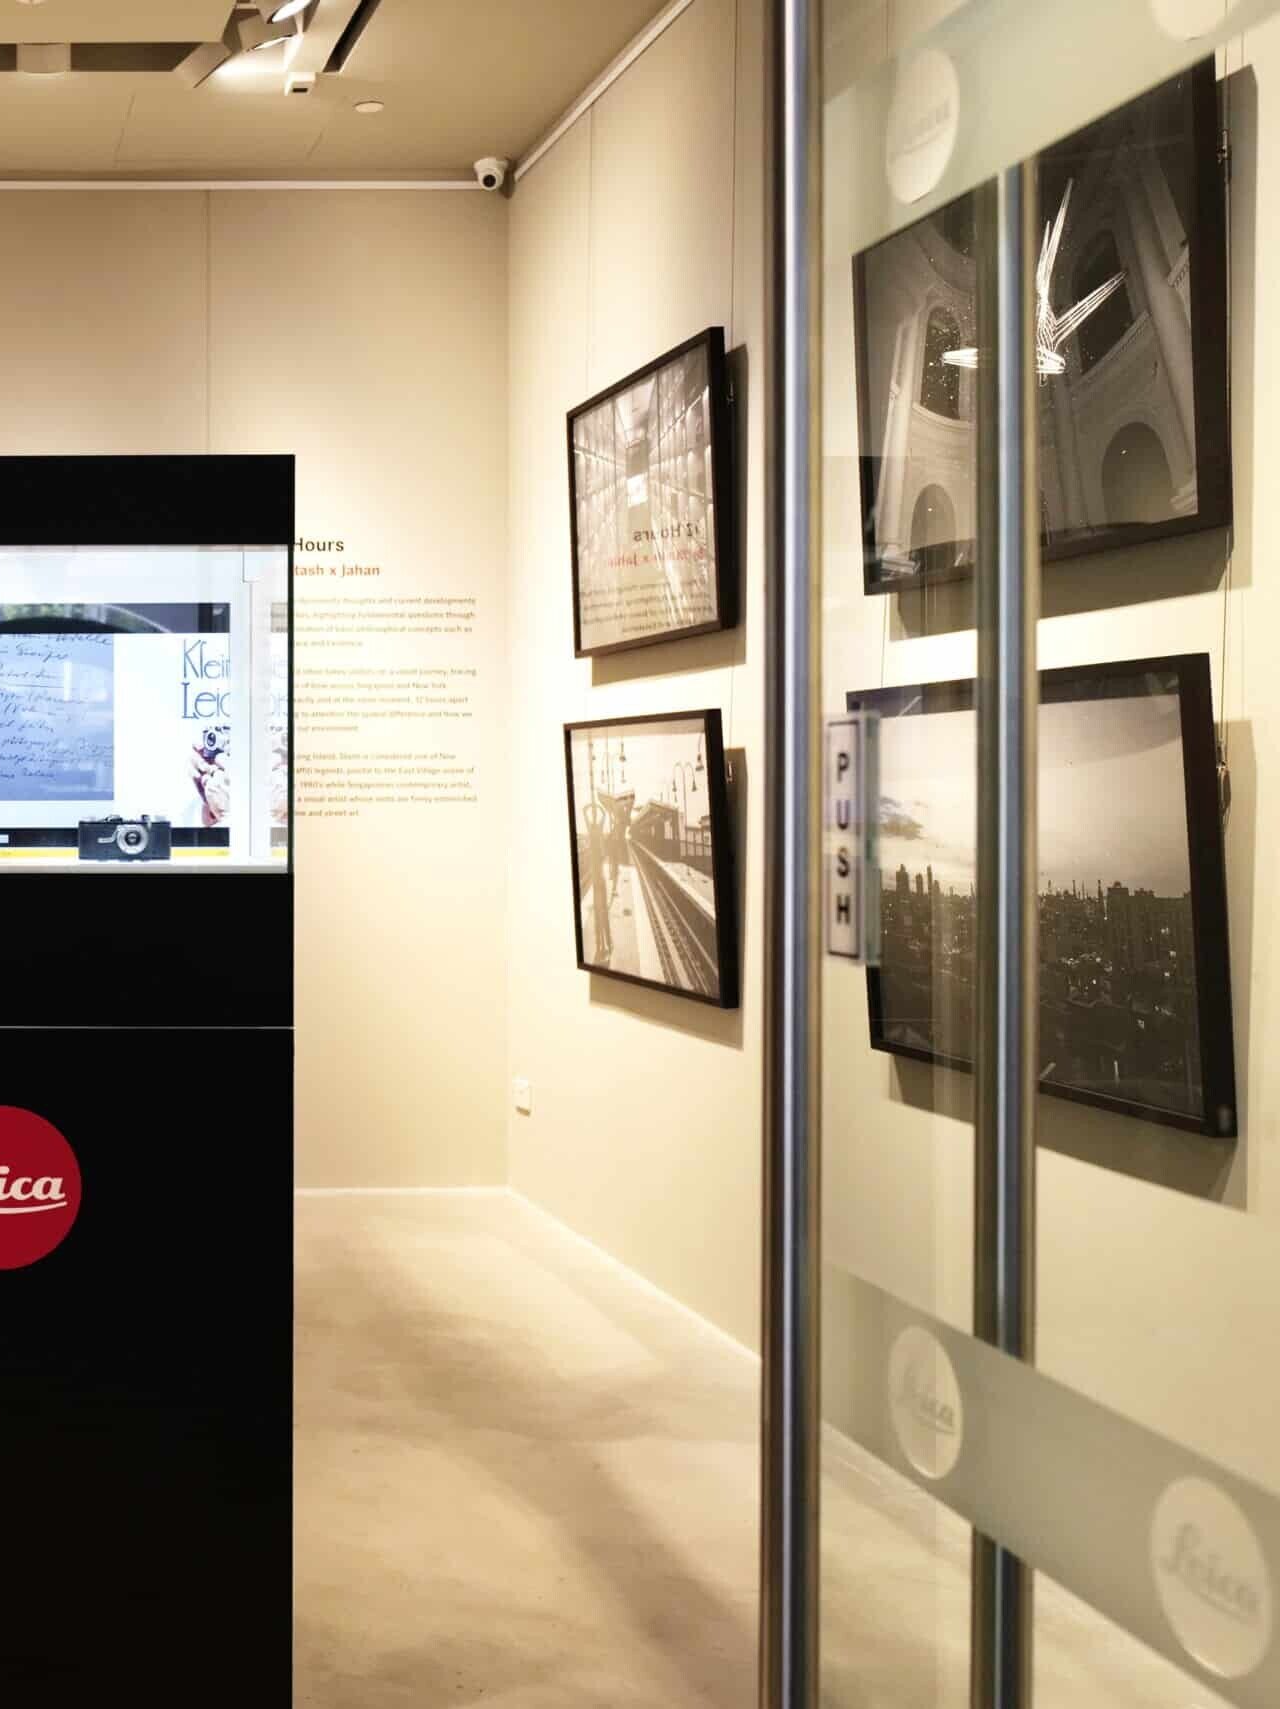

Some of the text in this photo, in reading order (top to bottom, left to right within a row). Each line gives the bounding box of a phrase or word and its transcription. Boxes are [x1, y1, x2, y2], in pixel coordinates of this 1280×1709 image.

[294, 563, 380, 579] tash x Jahan
[836, 751, 851, 925] PUSH
